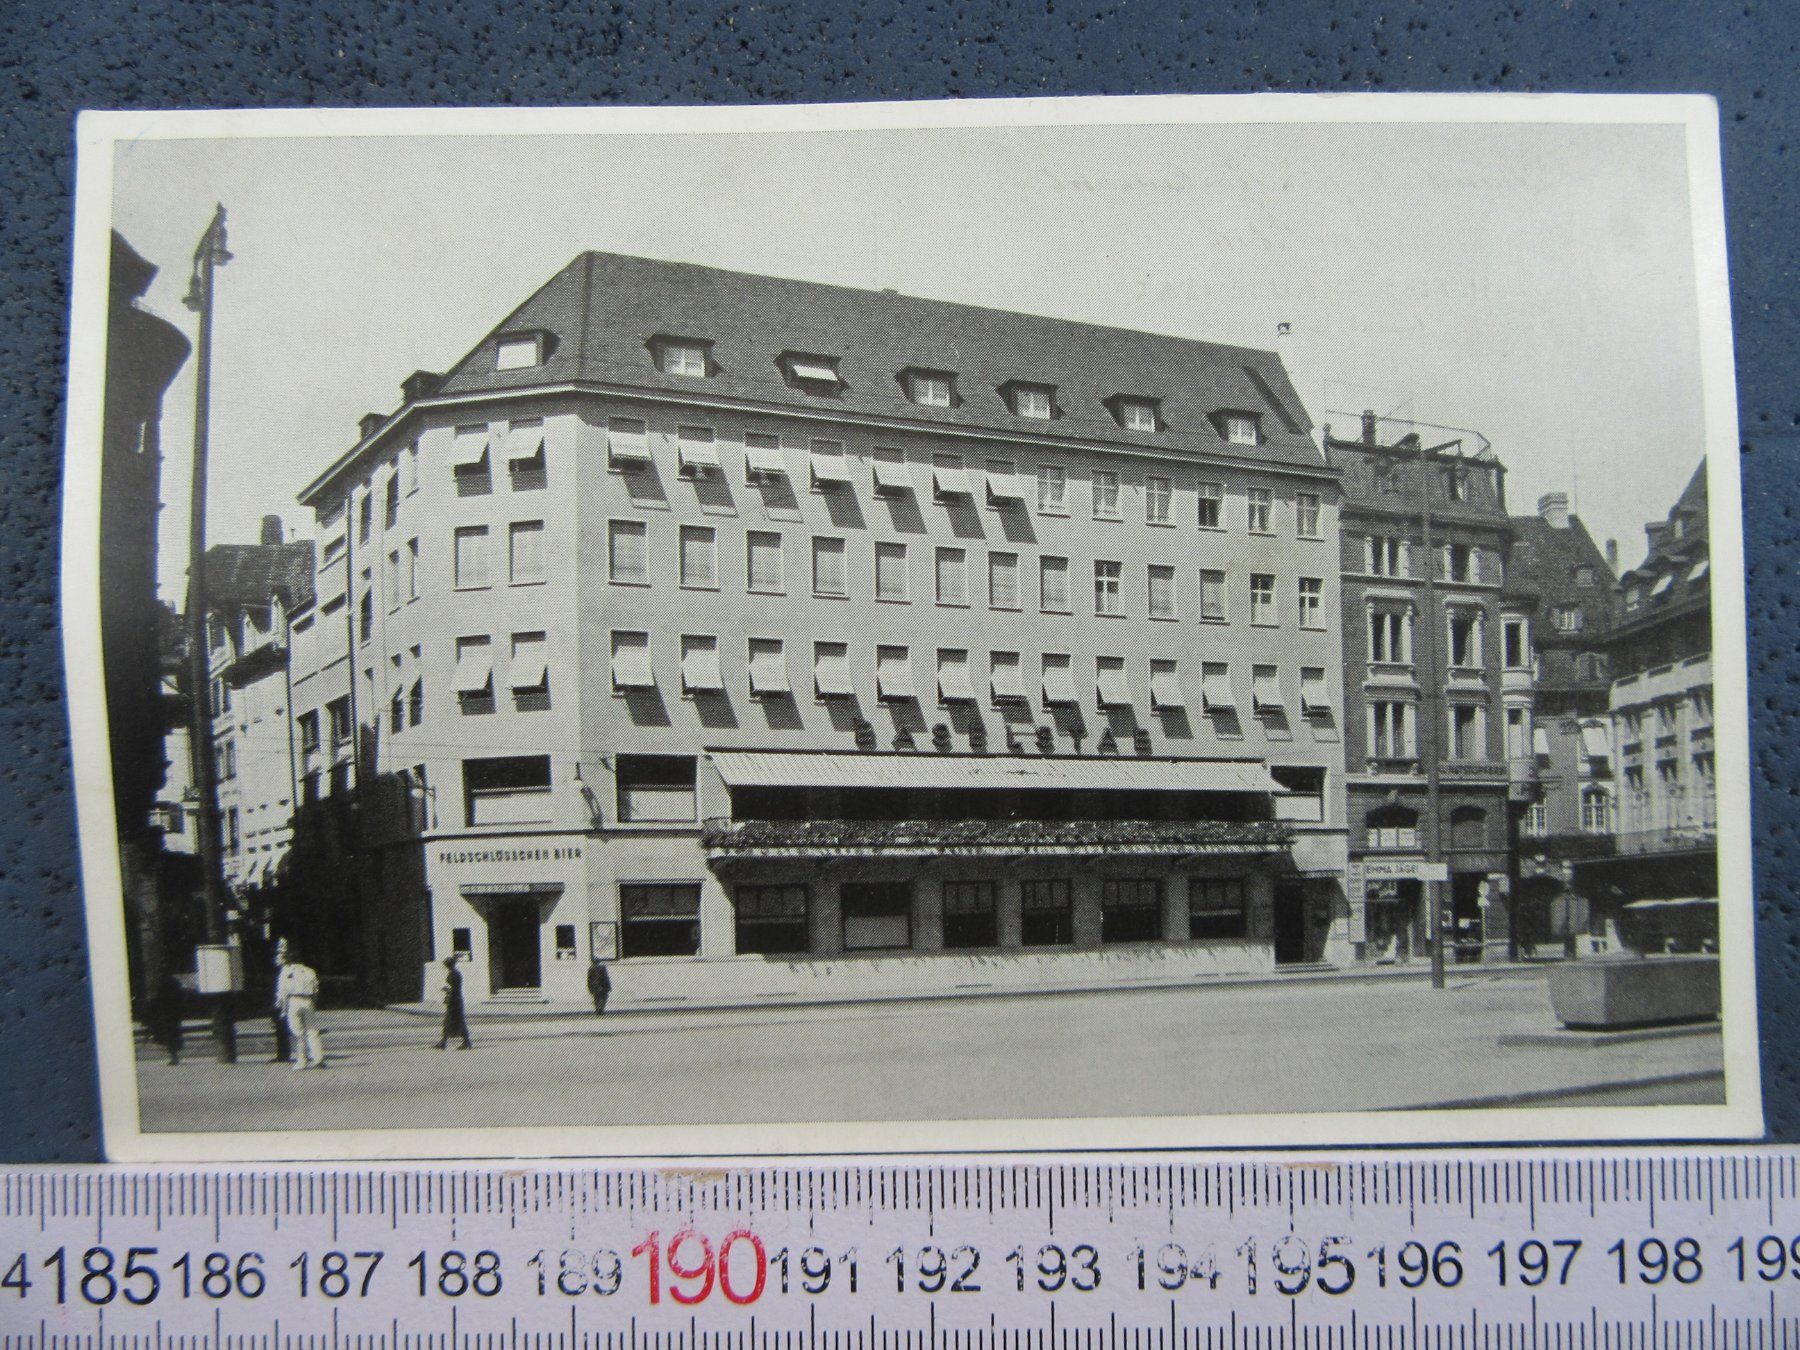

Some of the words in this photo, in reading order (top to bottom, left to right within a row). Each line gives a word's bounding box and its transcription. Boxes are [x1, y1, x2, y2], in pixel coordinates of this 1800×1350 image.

[440, 850, 549, 864] FELDSCHLÖSSCHEN
[554, 848, 582, 860] BIER
[43, 1246, 160, 1305] 185
[172, 1251, 266, 1298] 186
[290, 1251, 385, 1298] 187
[408, 1250, 502, 1298] 188
[527, 1248, 622, 1296] 189
[631, 1228, 767, 1305] 190
[770, 1246, 858, 1294] 191
[886, 1244, 981, 1293] 192
[1005, 1243, 1100, 1292] 193
[1126, 1242, 1217, 1290] 194
[1235, 1233, 1355, 1295] 195
[1367, 1240, 1463, 1288] 196
[1487, 1239, 1583, 1286] 197
[1606, 1237, 1703, 1285] 198
